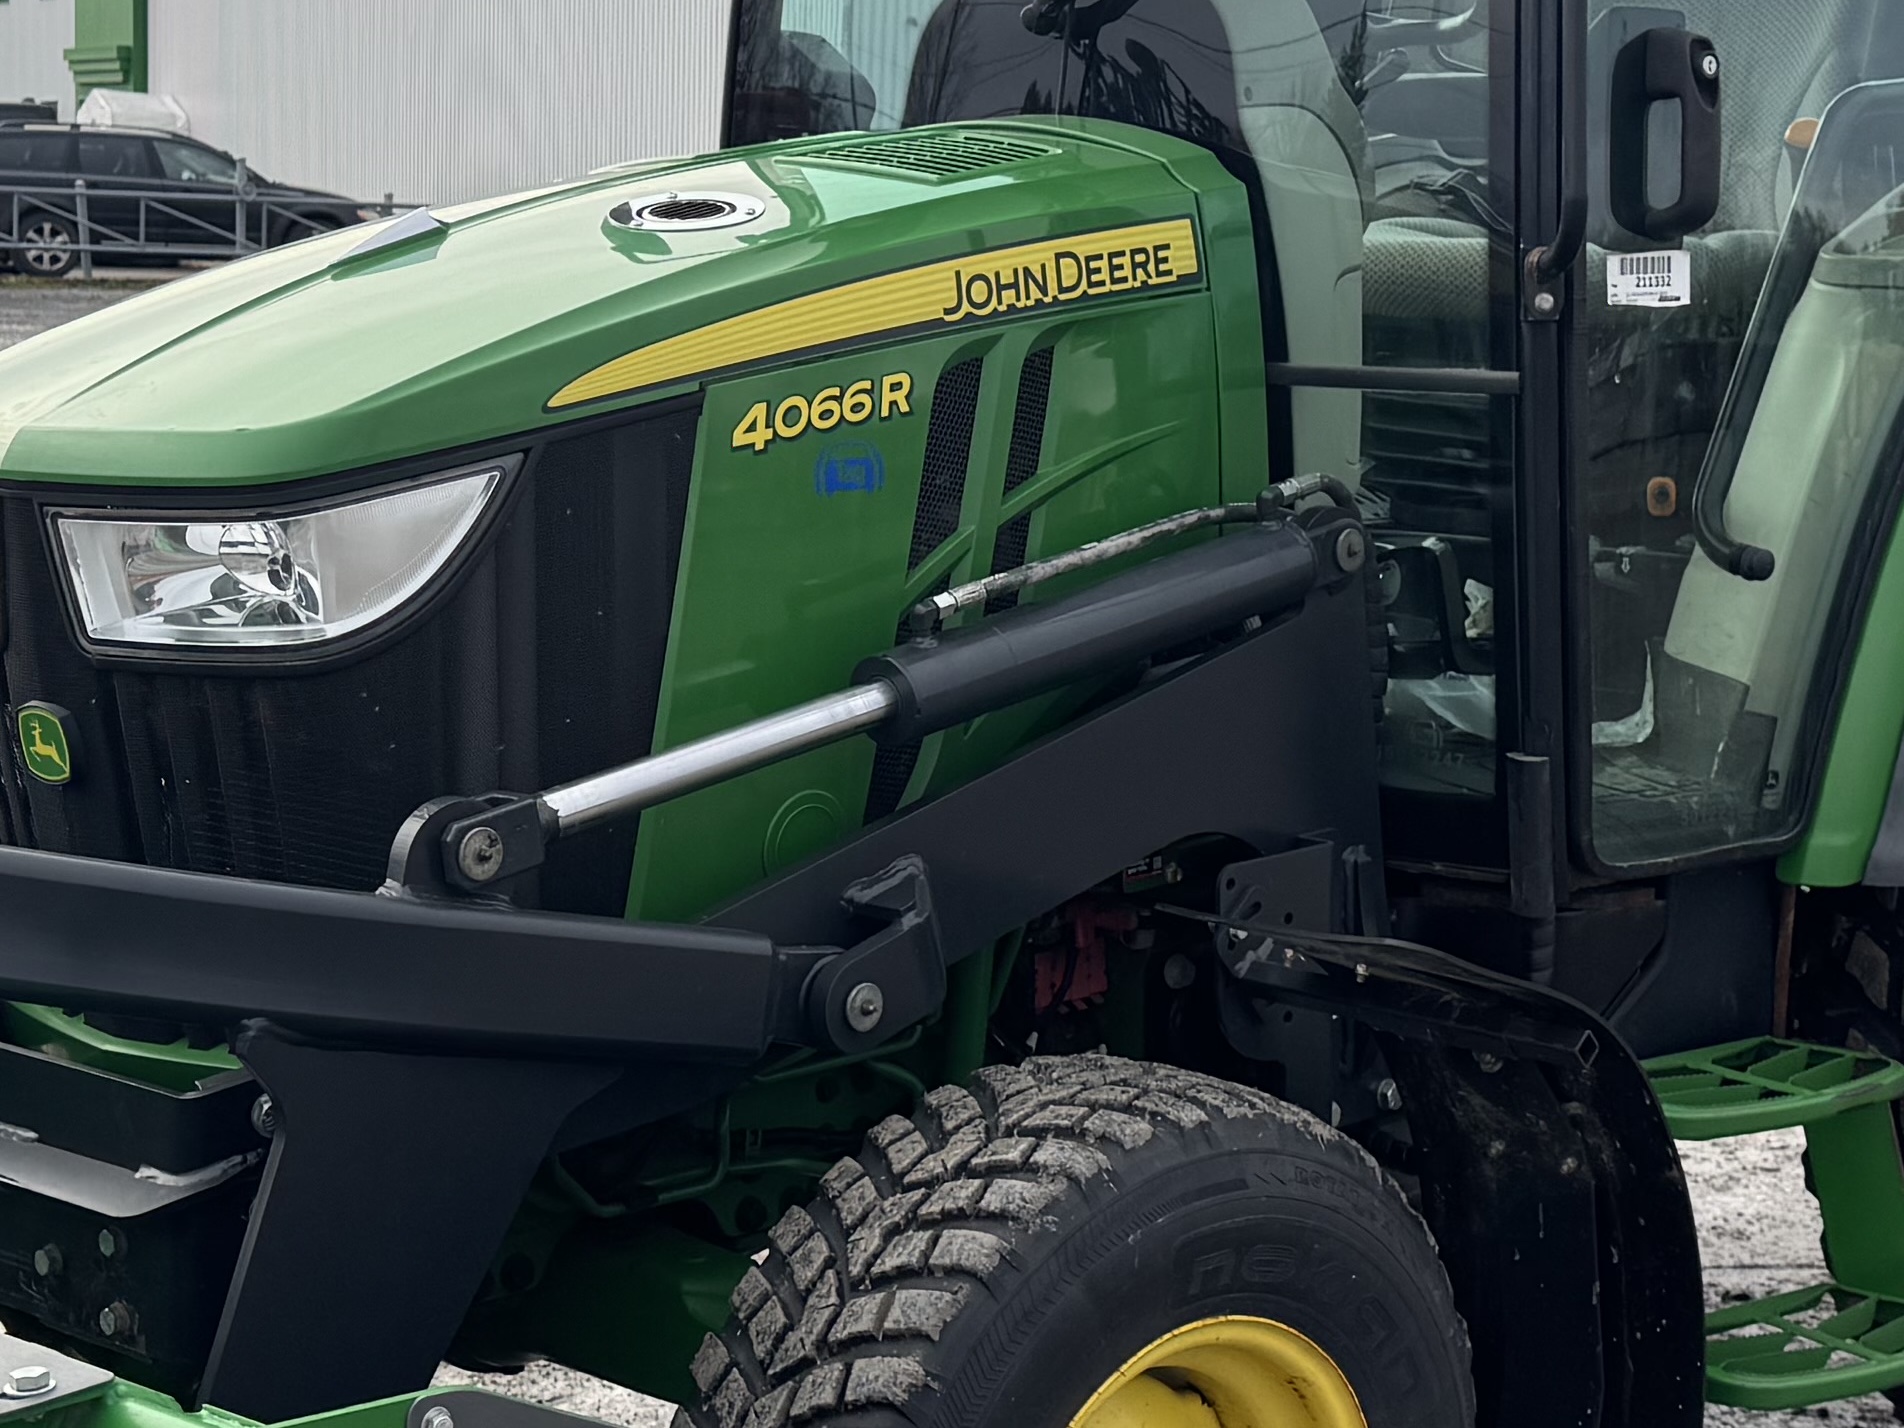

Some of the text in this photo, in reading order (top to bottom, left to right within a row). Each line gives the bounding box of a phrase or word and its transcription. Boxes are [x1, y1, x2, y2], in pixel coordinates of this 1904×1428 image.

[944, 243, 1175, 320] JOHN DEERE
[1636, 275, 1672, 288] 211332
[732, 372, 912, 451] 4066R
